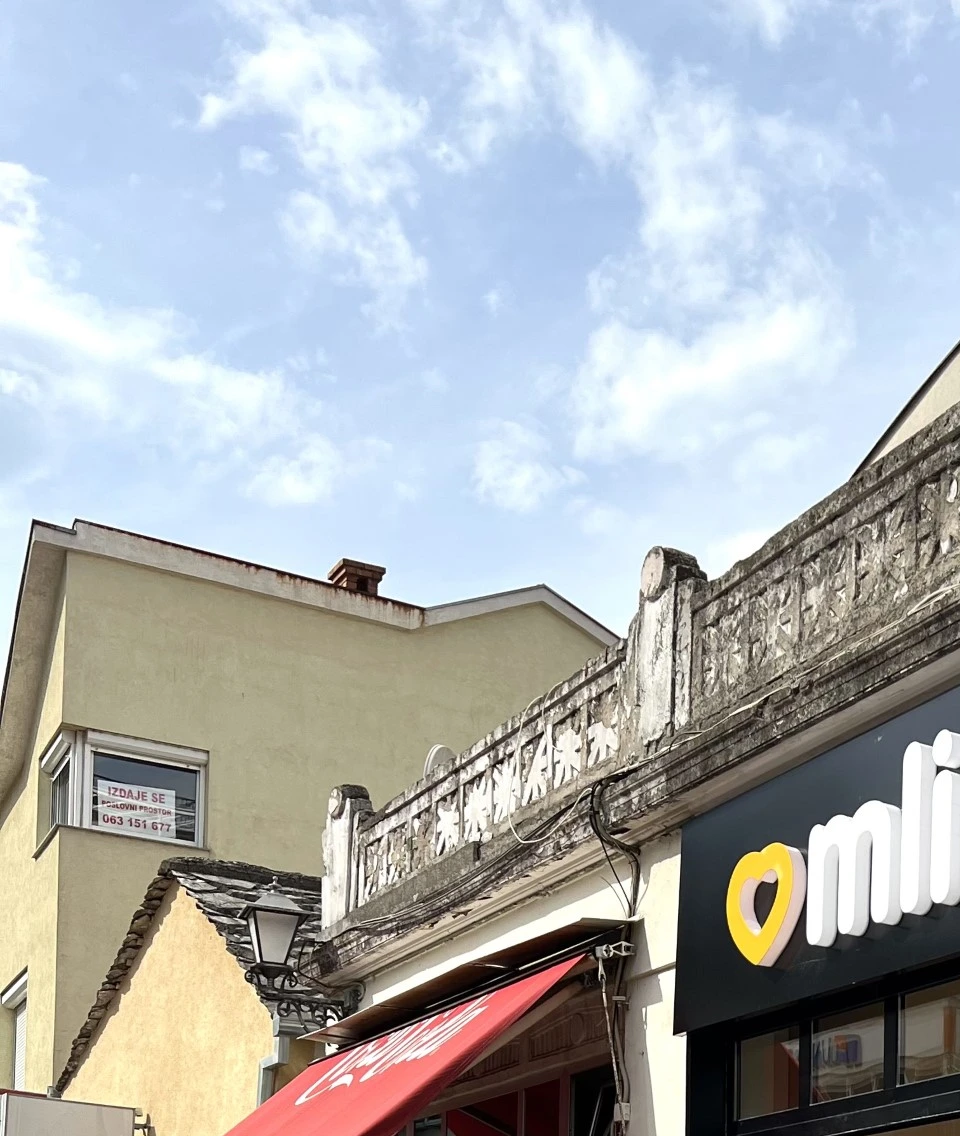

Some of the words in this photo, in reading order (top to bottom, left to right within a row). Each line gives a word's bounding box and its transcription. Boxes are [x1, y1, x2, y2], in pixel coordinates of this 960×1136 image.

[107, 786, 148, 801] IZDAJE
[151, 793, 166, 804] SE
[101, 800, 138, 811] POSLOVNI
[102, 814, 124, 826] 063
[127, 817, 147, 829] 151
[151, 821, 172, 832] 677
